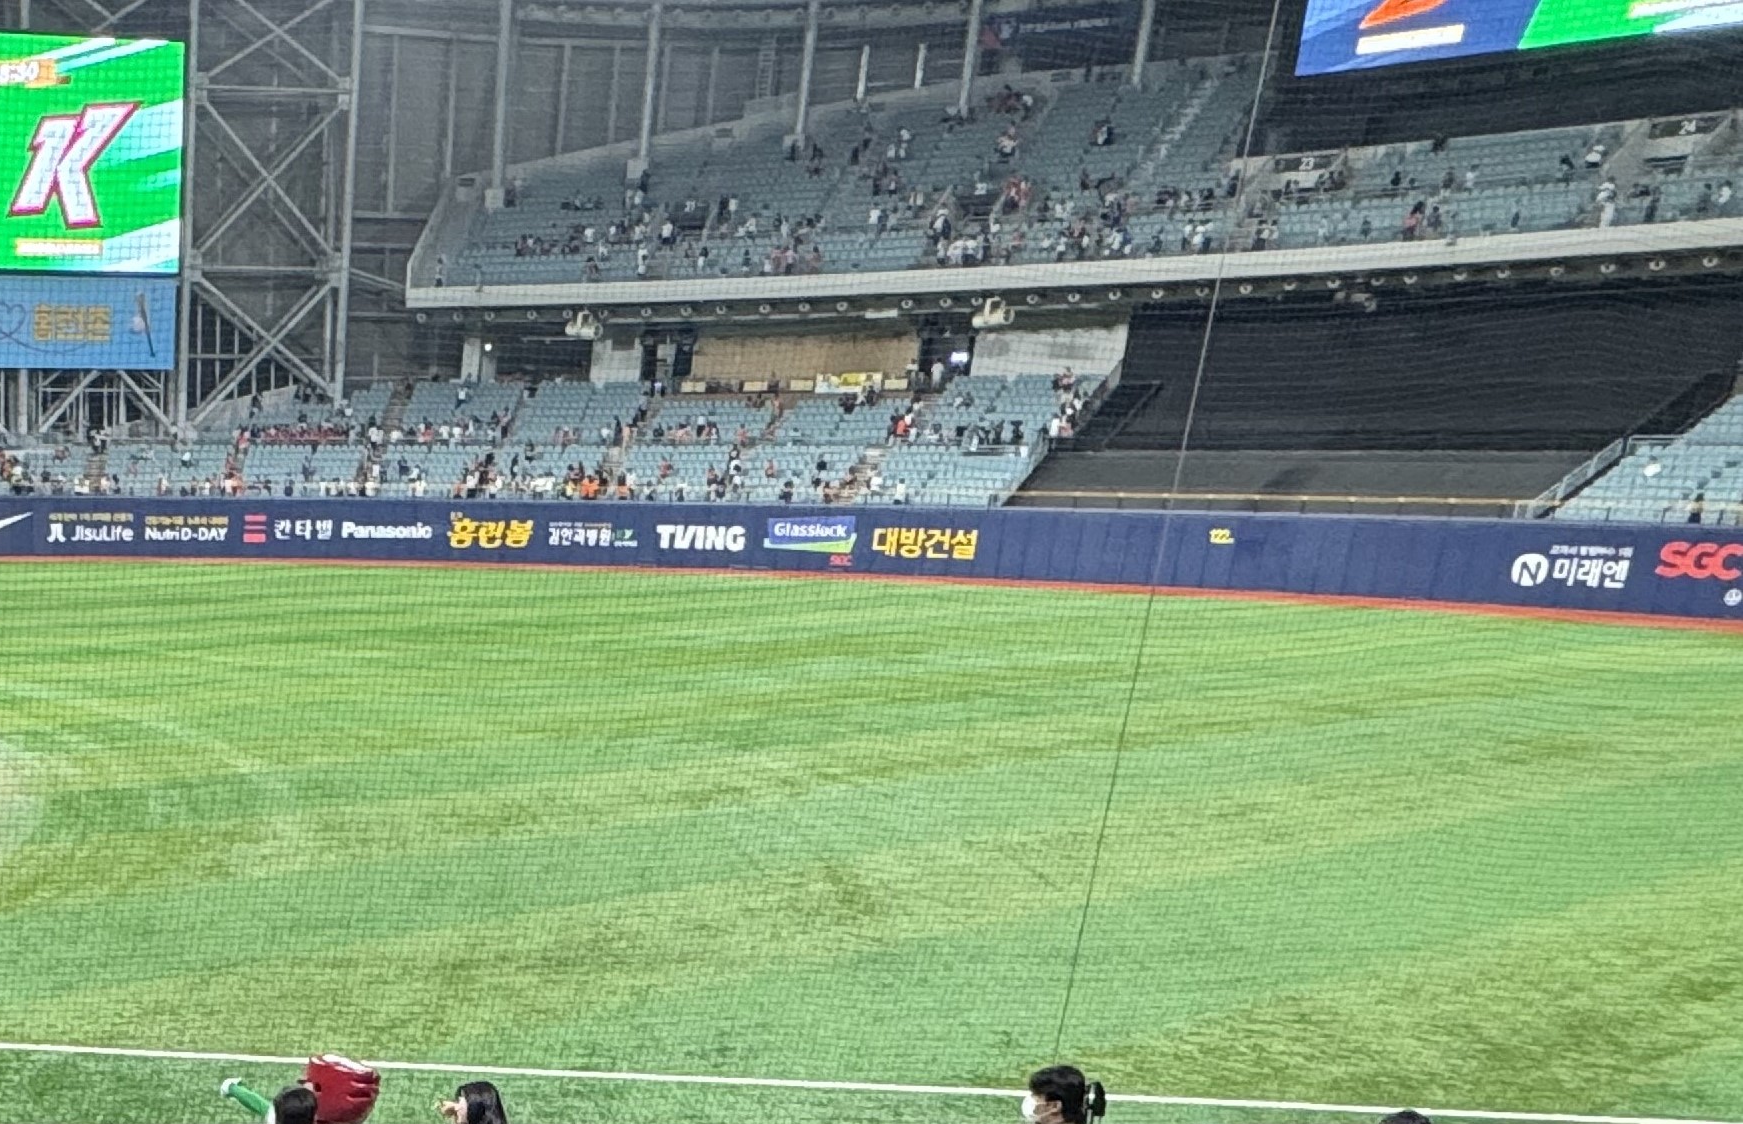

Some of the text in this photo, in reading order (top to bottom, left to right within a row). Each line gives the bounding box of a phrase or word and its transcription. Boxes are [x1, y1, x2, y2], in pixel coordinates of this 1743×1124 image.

[8, 102, 142, 229] K
[341, 521, 433, 539] Panasonic
[656, 524, 746, 552] TVING
[773, 522, 849, 538] Glasslock
[871, 526, 979, 560] 대방건설
[1552, 557, 1631, 589] 미래엔
[1654, 541, 1743, 580] SGC
